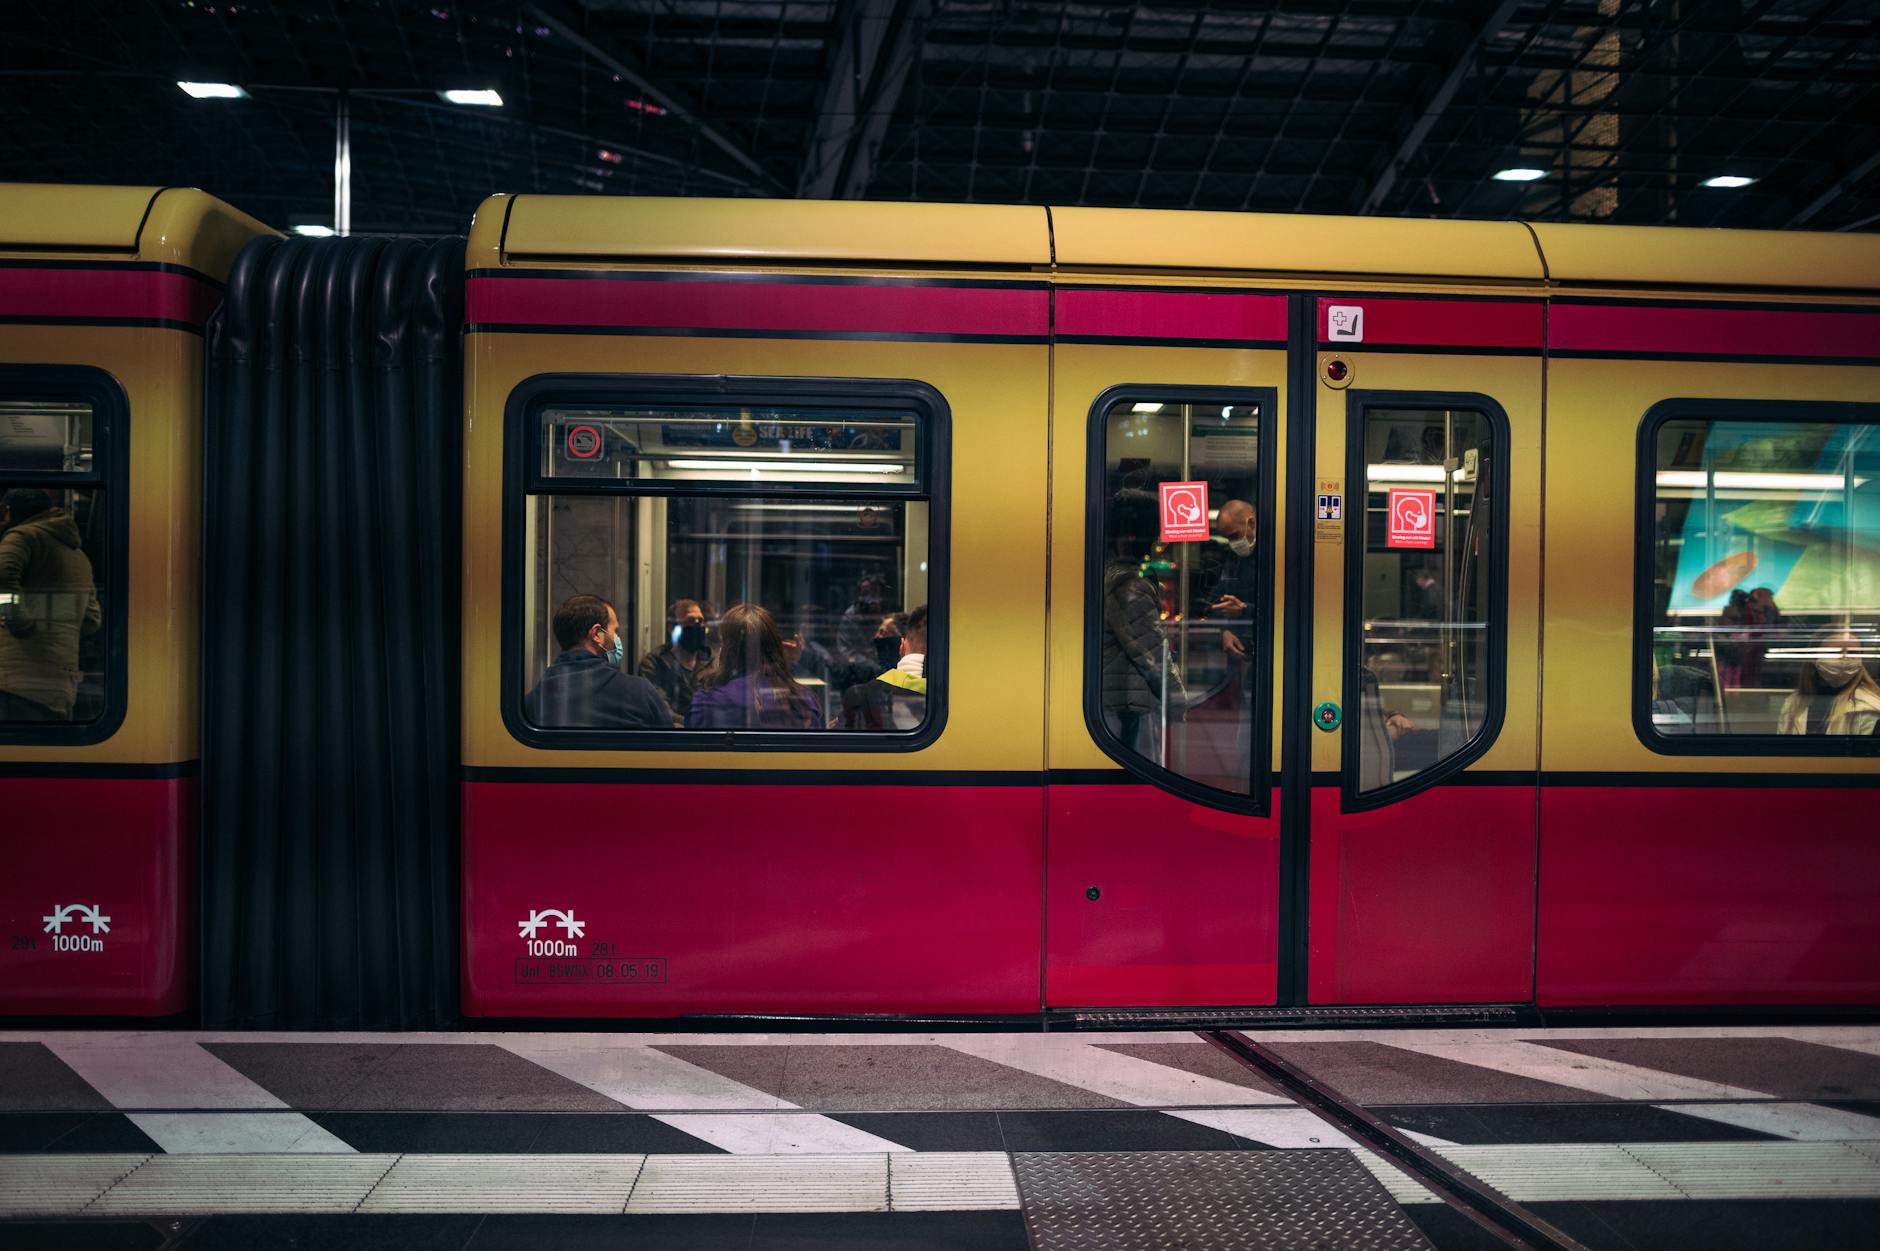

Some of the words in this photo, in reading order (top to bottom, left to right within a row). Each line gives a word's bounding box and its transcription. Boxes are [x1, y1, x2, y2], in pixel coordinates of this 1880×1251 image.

[759, 425, 784, 439] SEA
[52, 935, 104, 952] 1000m
[526, 940, 577, 957] 1000m
